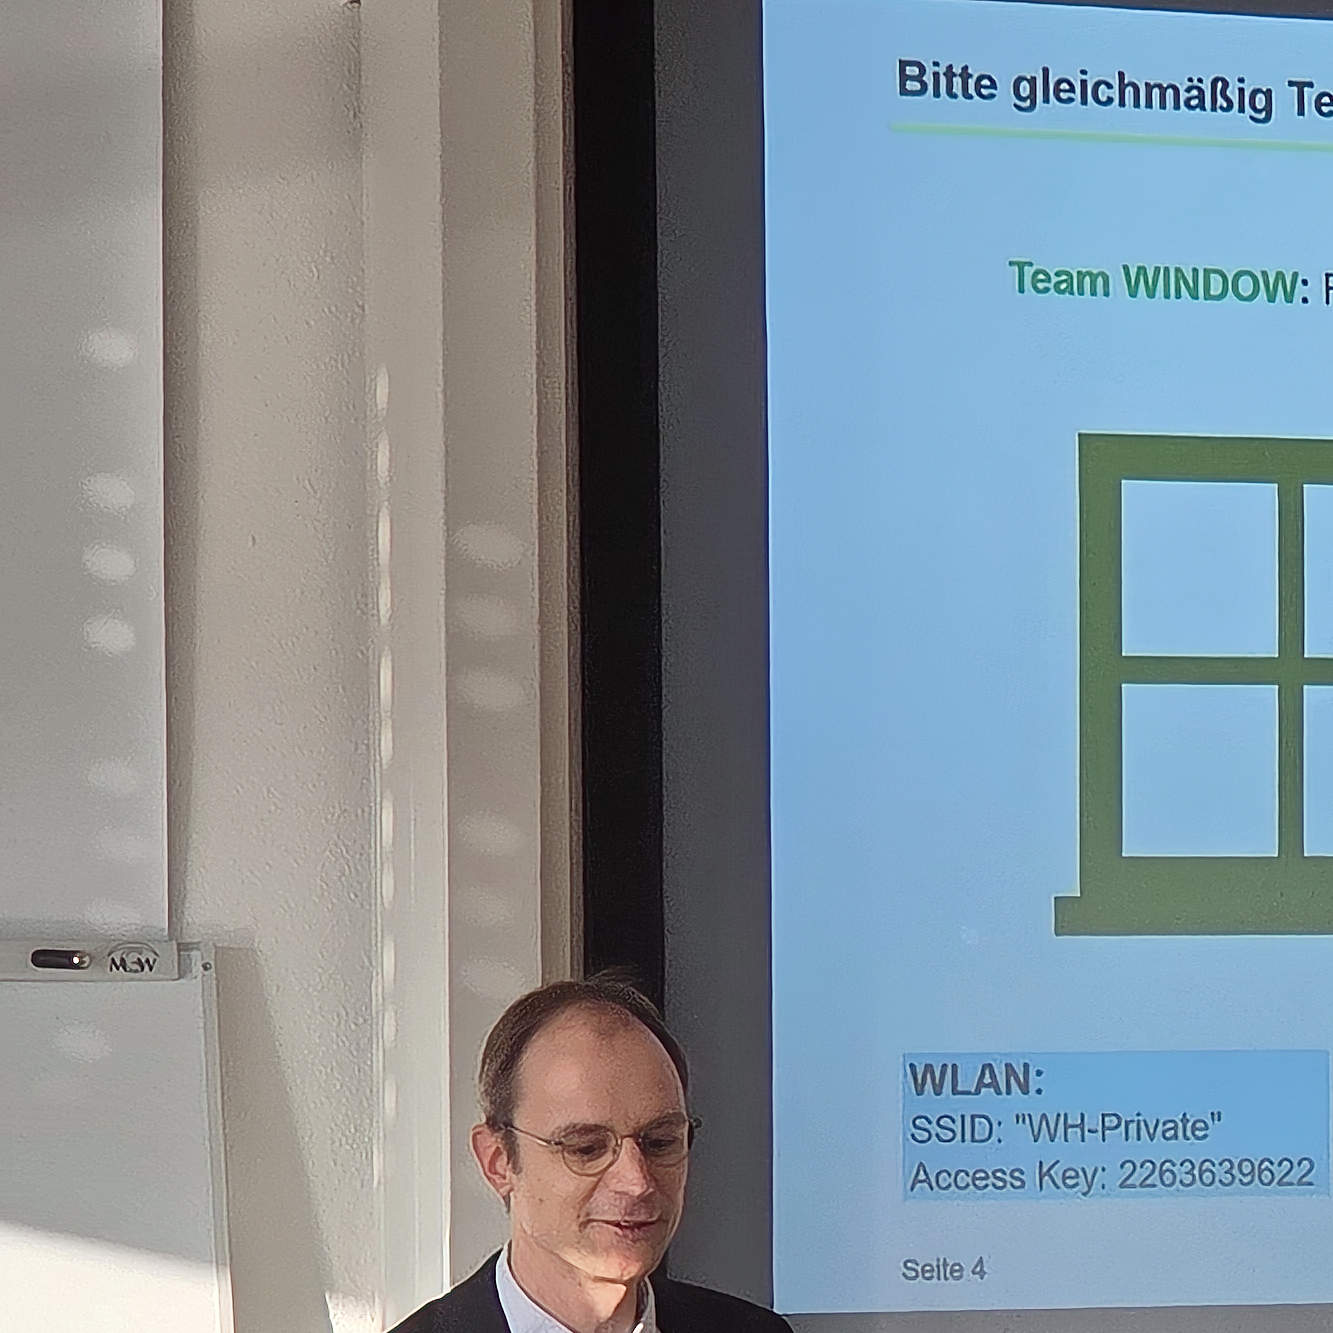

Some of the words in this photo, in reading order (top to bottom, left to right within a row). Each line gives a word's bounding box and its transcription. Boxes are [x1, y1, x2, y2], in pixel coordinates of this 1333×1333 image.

[898, 58, 998, 102] Bitte
[1012, 66, 1273, 125] gleichmäßig
[1008, 260, 1111, 299] Team
[1121, 263, 1310, 306] WINDOW:
[908, 1062, 1044, 1097] WLAN:
[910, 1113, 1003, 1145] SSID:
[1015, 1110, 1222, 1144] "WH-Private"
[909, 1161, 1026, 1193] Access
[1038, 1159, 1107, 1198] Key:
[1118, 1156, 1315, 1190] 2263639622
[901, 1257, 965, 1282] Seite
[971, 1256, 987, 1280] 4
